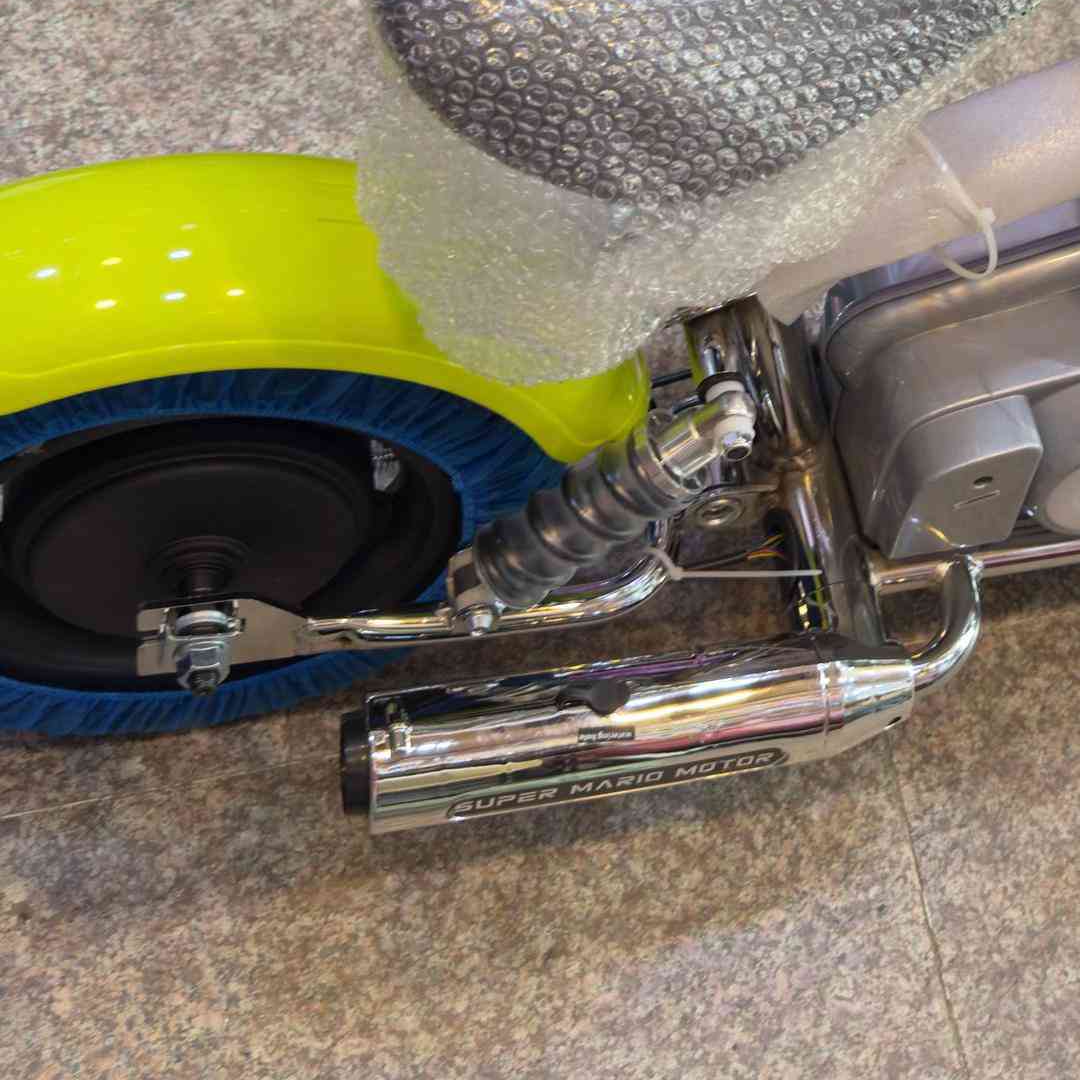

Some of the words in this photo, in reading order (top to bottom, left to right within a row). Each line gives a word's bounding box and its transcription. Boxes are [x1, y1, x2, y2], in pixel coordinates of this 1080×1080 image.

[454, 787, 558, 813] SUPER
[570, 770, 662, 795] MARIO
[675, 751, 774, 777] MOTOR
